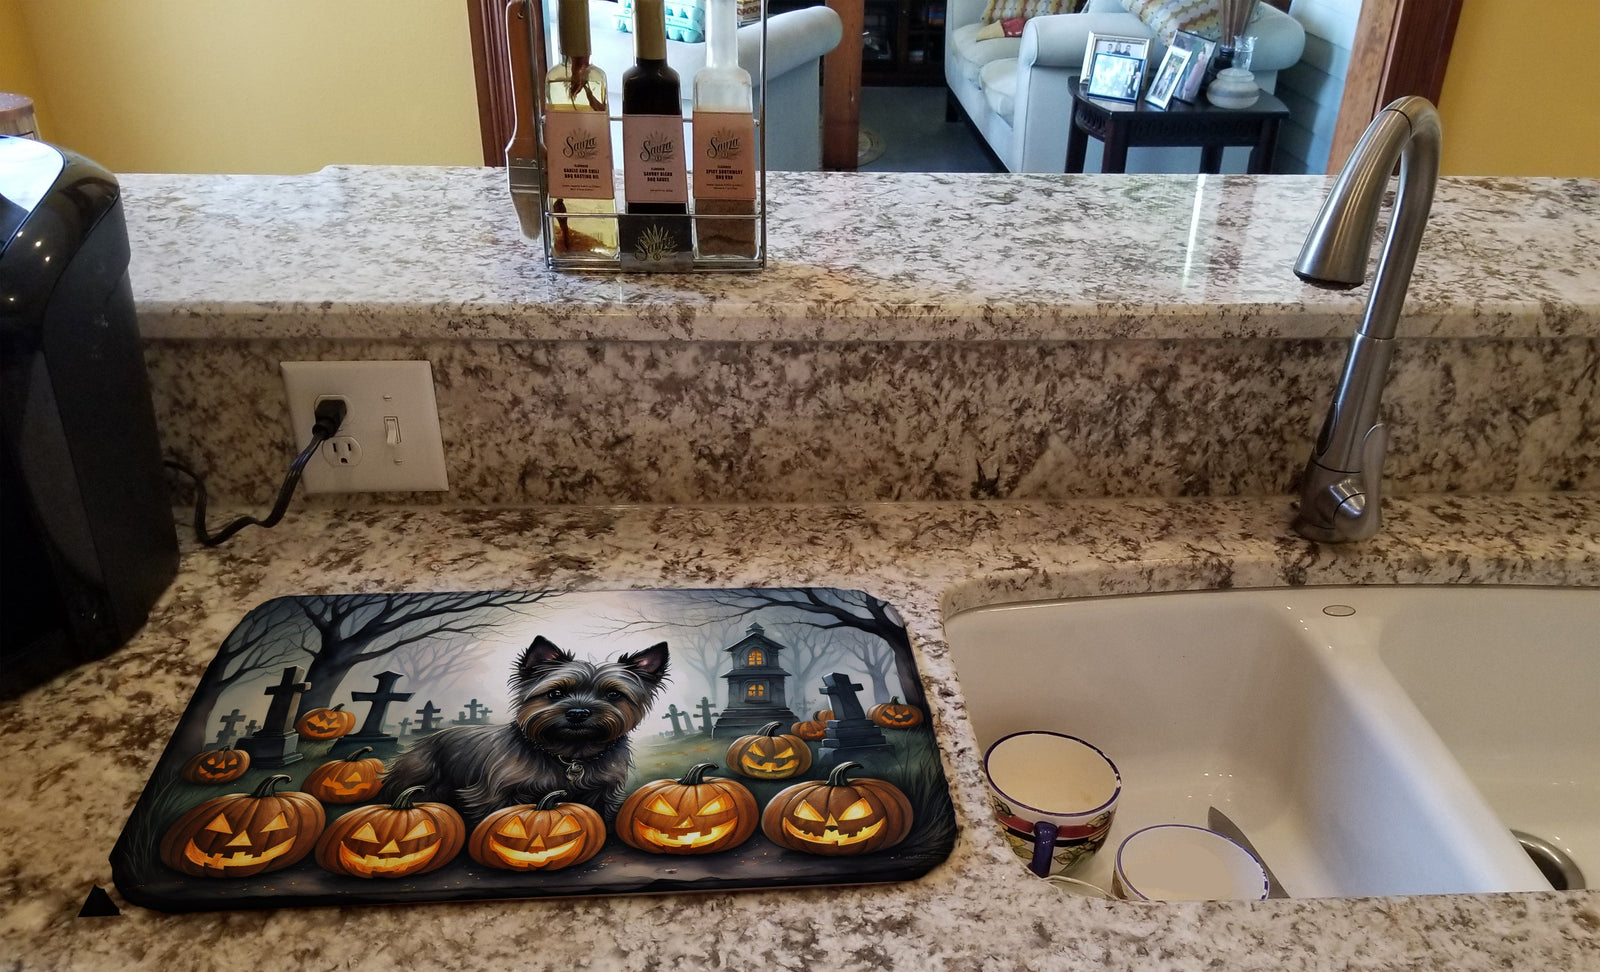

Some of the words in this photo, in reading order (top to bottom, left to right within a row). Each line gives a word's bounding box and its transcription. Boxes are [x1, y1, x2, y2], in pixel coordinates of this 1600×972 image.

[563, 136, 597, 158] Sauza
[640, 140, 674, 161] Sauza
[707, 136, 740, 158] Sauza
